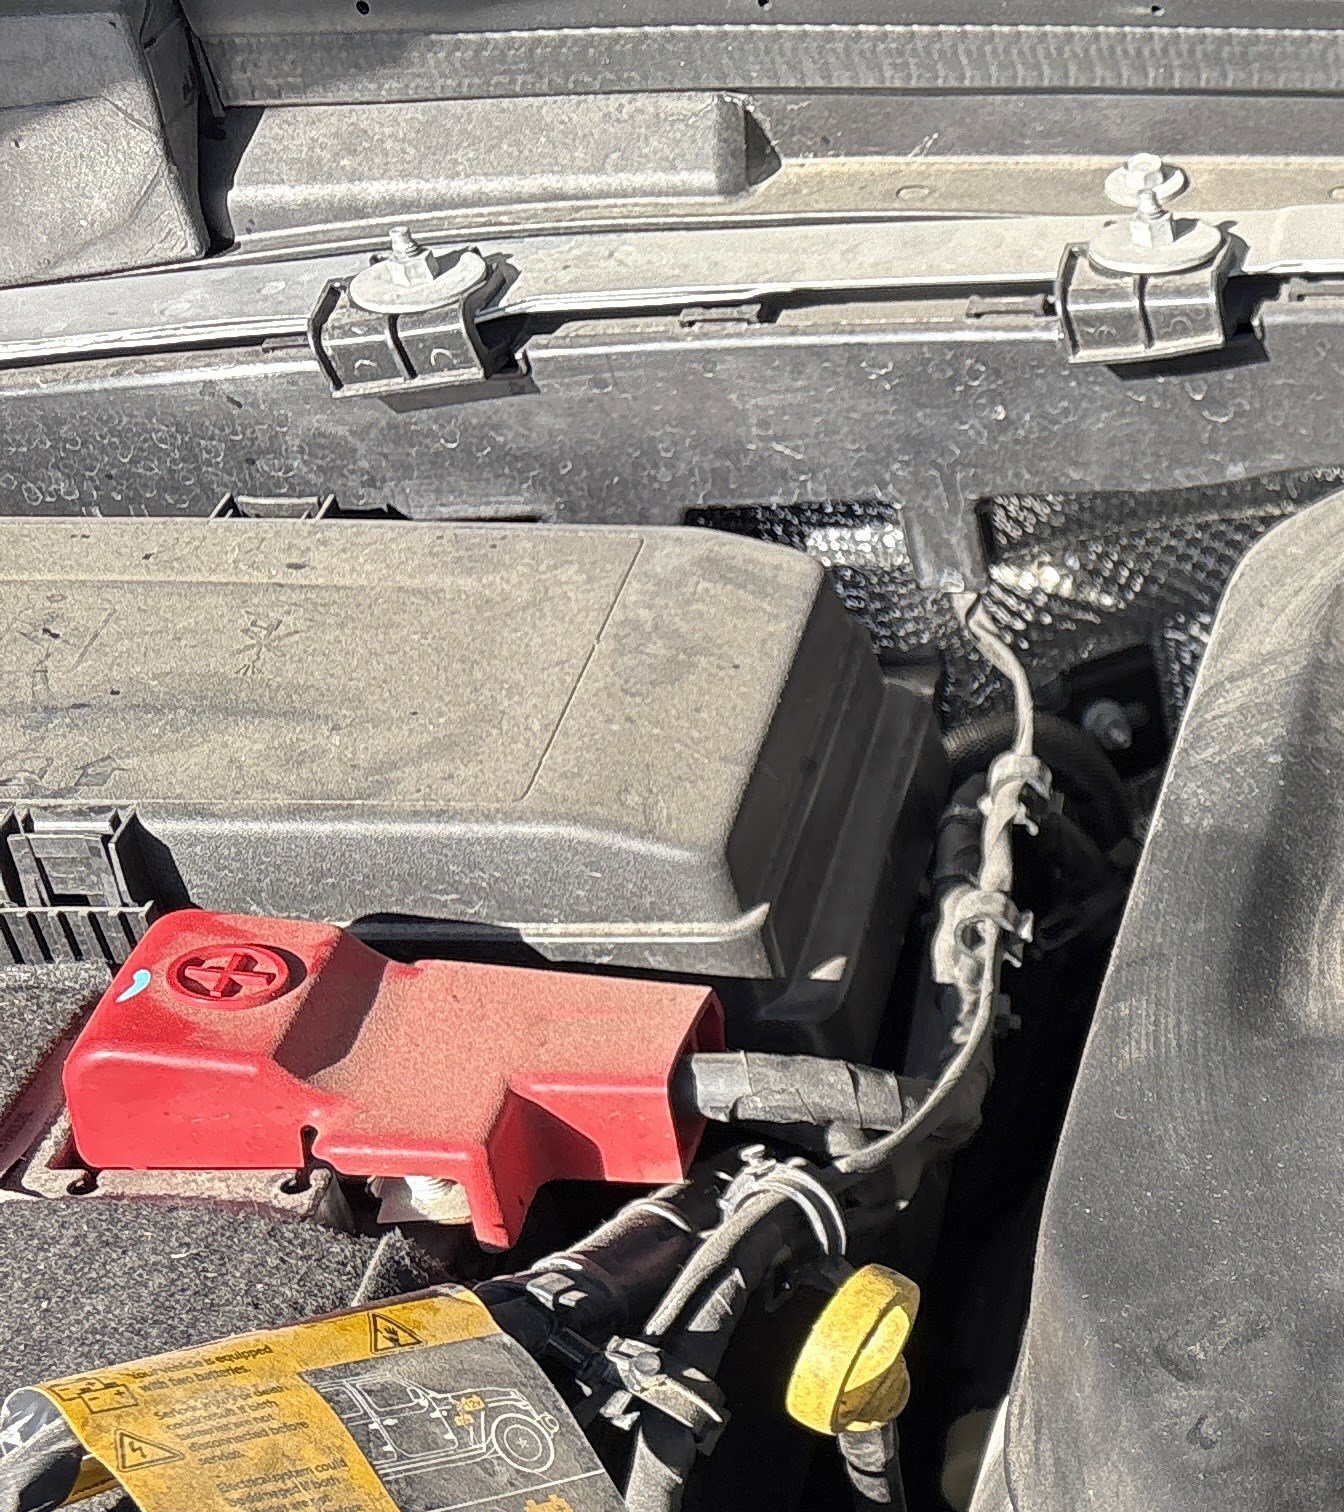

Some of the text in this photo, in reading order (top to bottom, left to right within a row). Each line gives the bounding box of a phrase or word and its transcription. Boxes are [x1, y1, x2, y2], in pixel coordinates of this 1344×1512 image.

[215, 1345, 273, 1364] equipped
[169, 1376, 194, 1385] two
[254, 1415, 275, 1423] not
[269, 1419, 310, 1434] before
[314, 1458, 348, 1472] could
[312, 1476, 341, 1488] both
